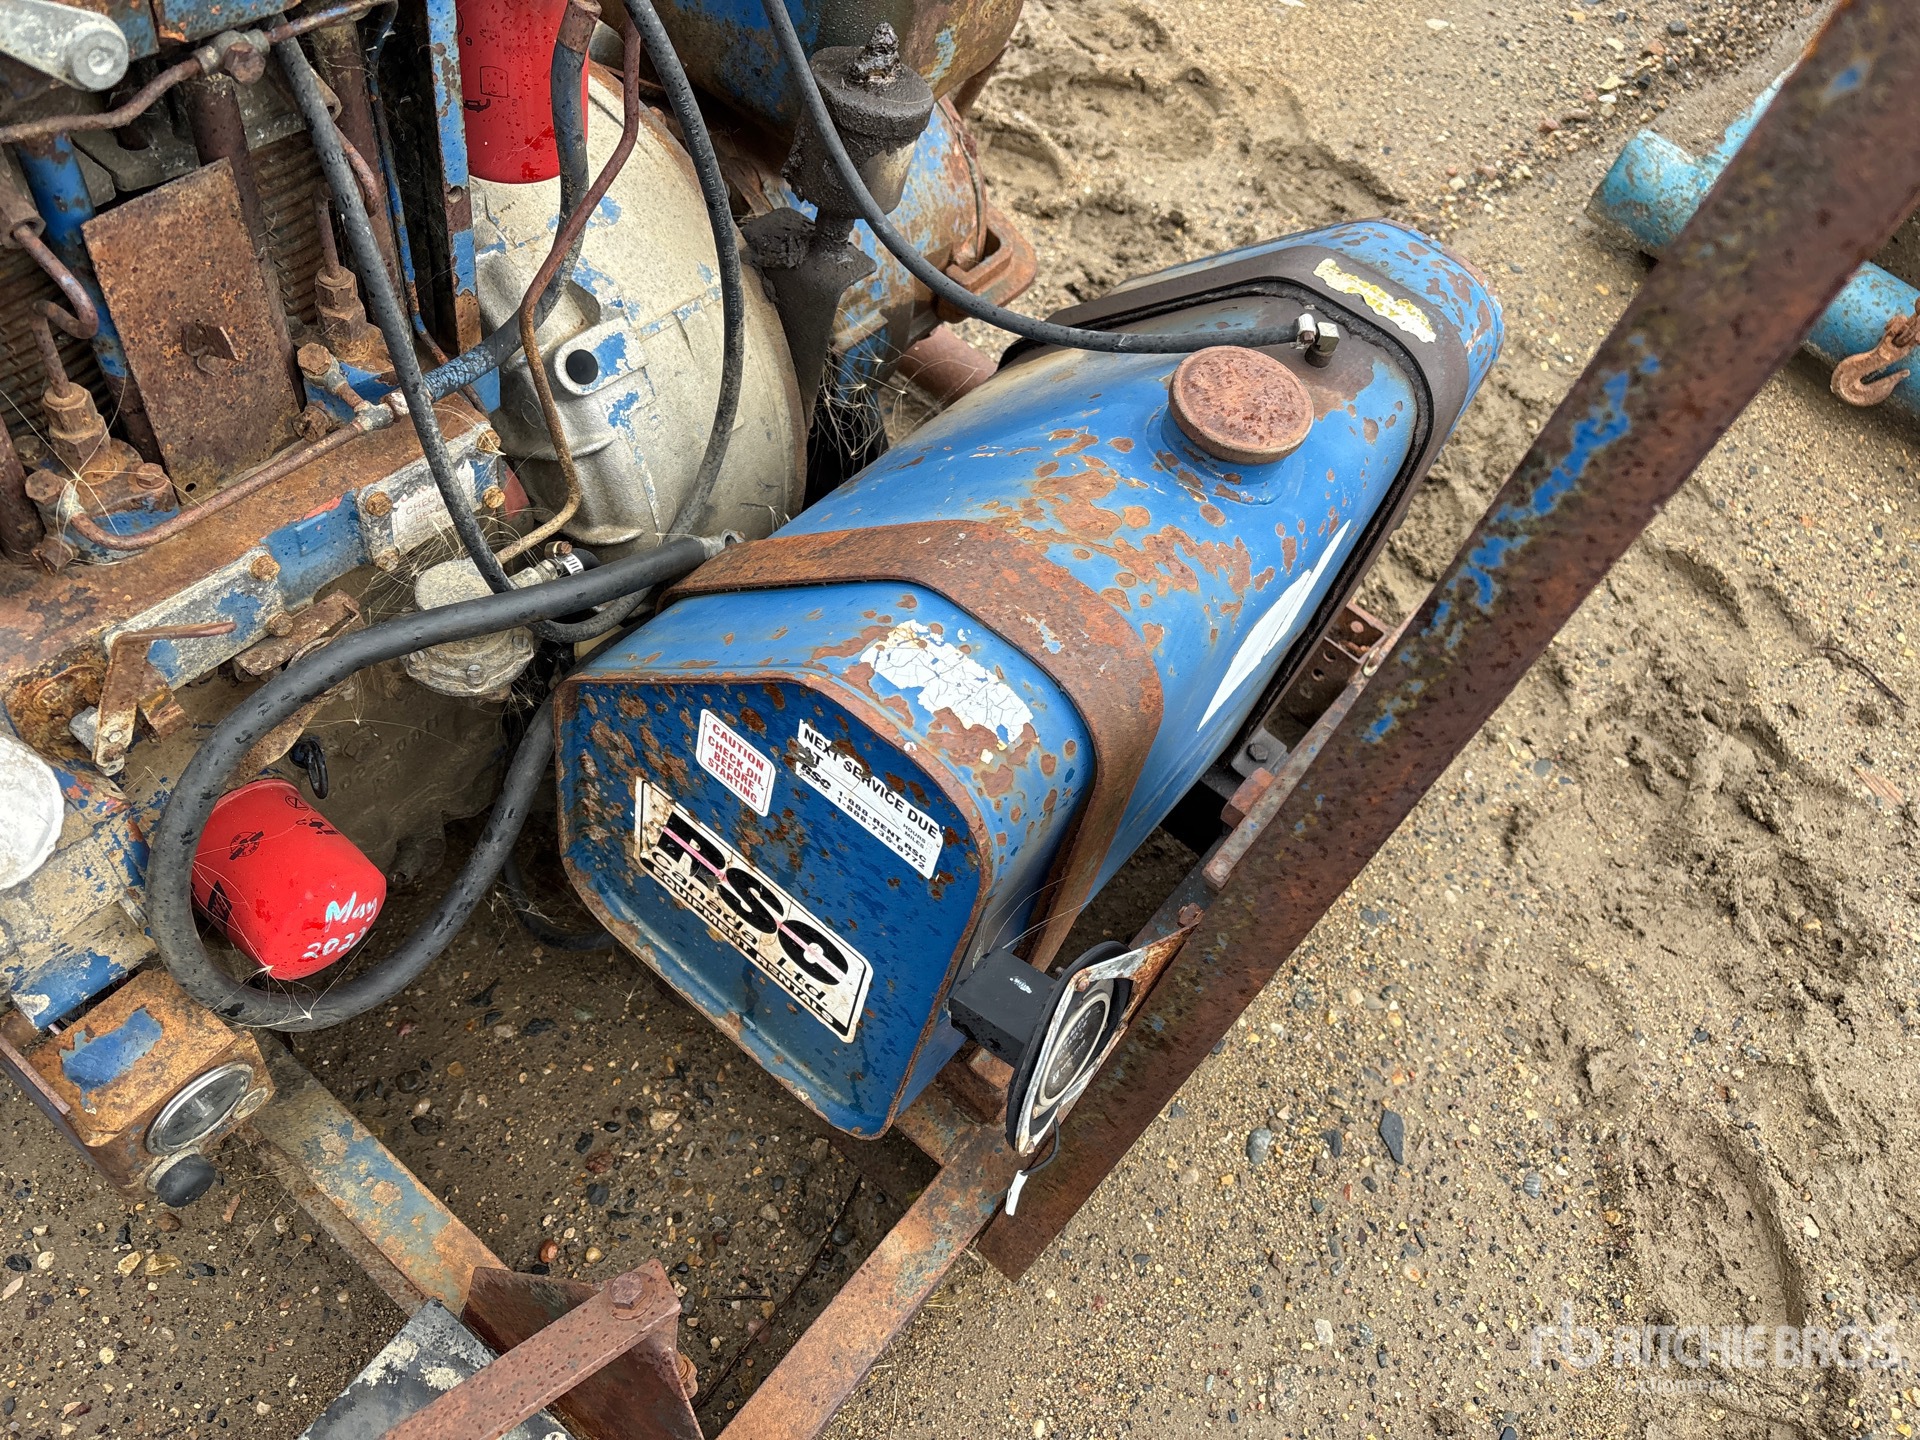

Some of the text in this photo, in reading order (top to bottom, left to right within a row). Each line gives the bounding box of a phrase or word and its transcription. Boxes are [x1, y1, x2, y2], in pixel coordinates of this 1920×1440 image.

[707, 735, 763, 787] CHECK OIL
[712, 723, 765, 771] CAUTION
[713, 751, 755, 791] BEFORE
[707, 757, 757, 804] STARTING
[800, 763, 831, 790] RSC
[803, 728, 839, 762] NEXT
[843, 760, 905, 813] SERVICE
[907, 808, 938, 839] DUE
[838, 790, 927, 863] 1-888-RENT RSC
[903, 823, 926, 844] HOURS
[904, 830, 925, 849] MILES
[324, 890, 378, 933] May
[651, 851, 758, 946] Canada
[655, 811, 849, 986] RSC
[652, 867, 834, 1025] EQUIPMENT RENTALS
[776, 957, 829, 1007] Ltd.
